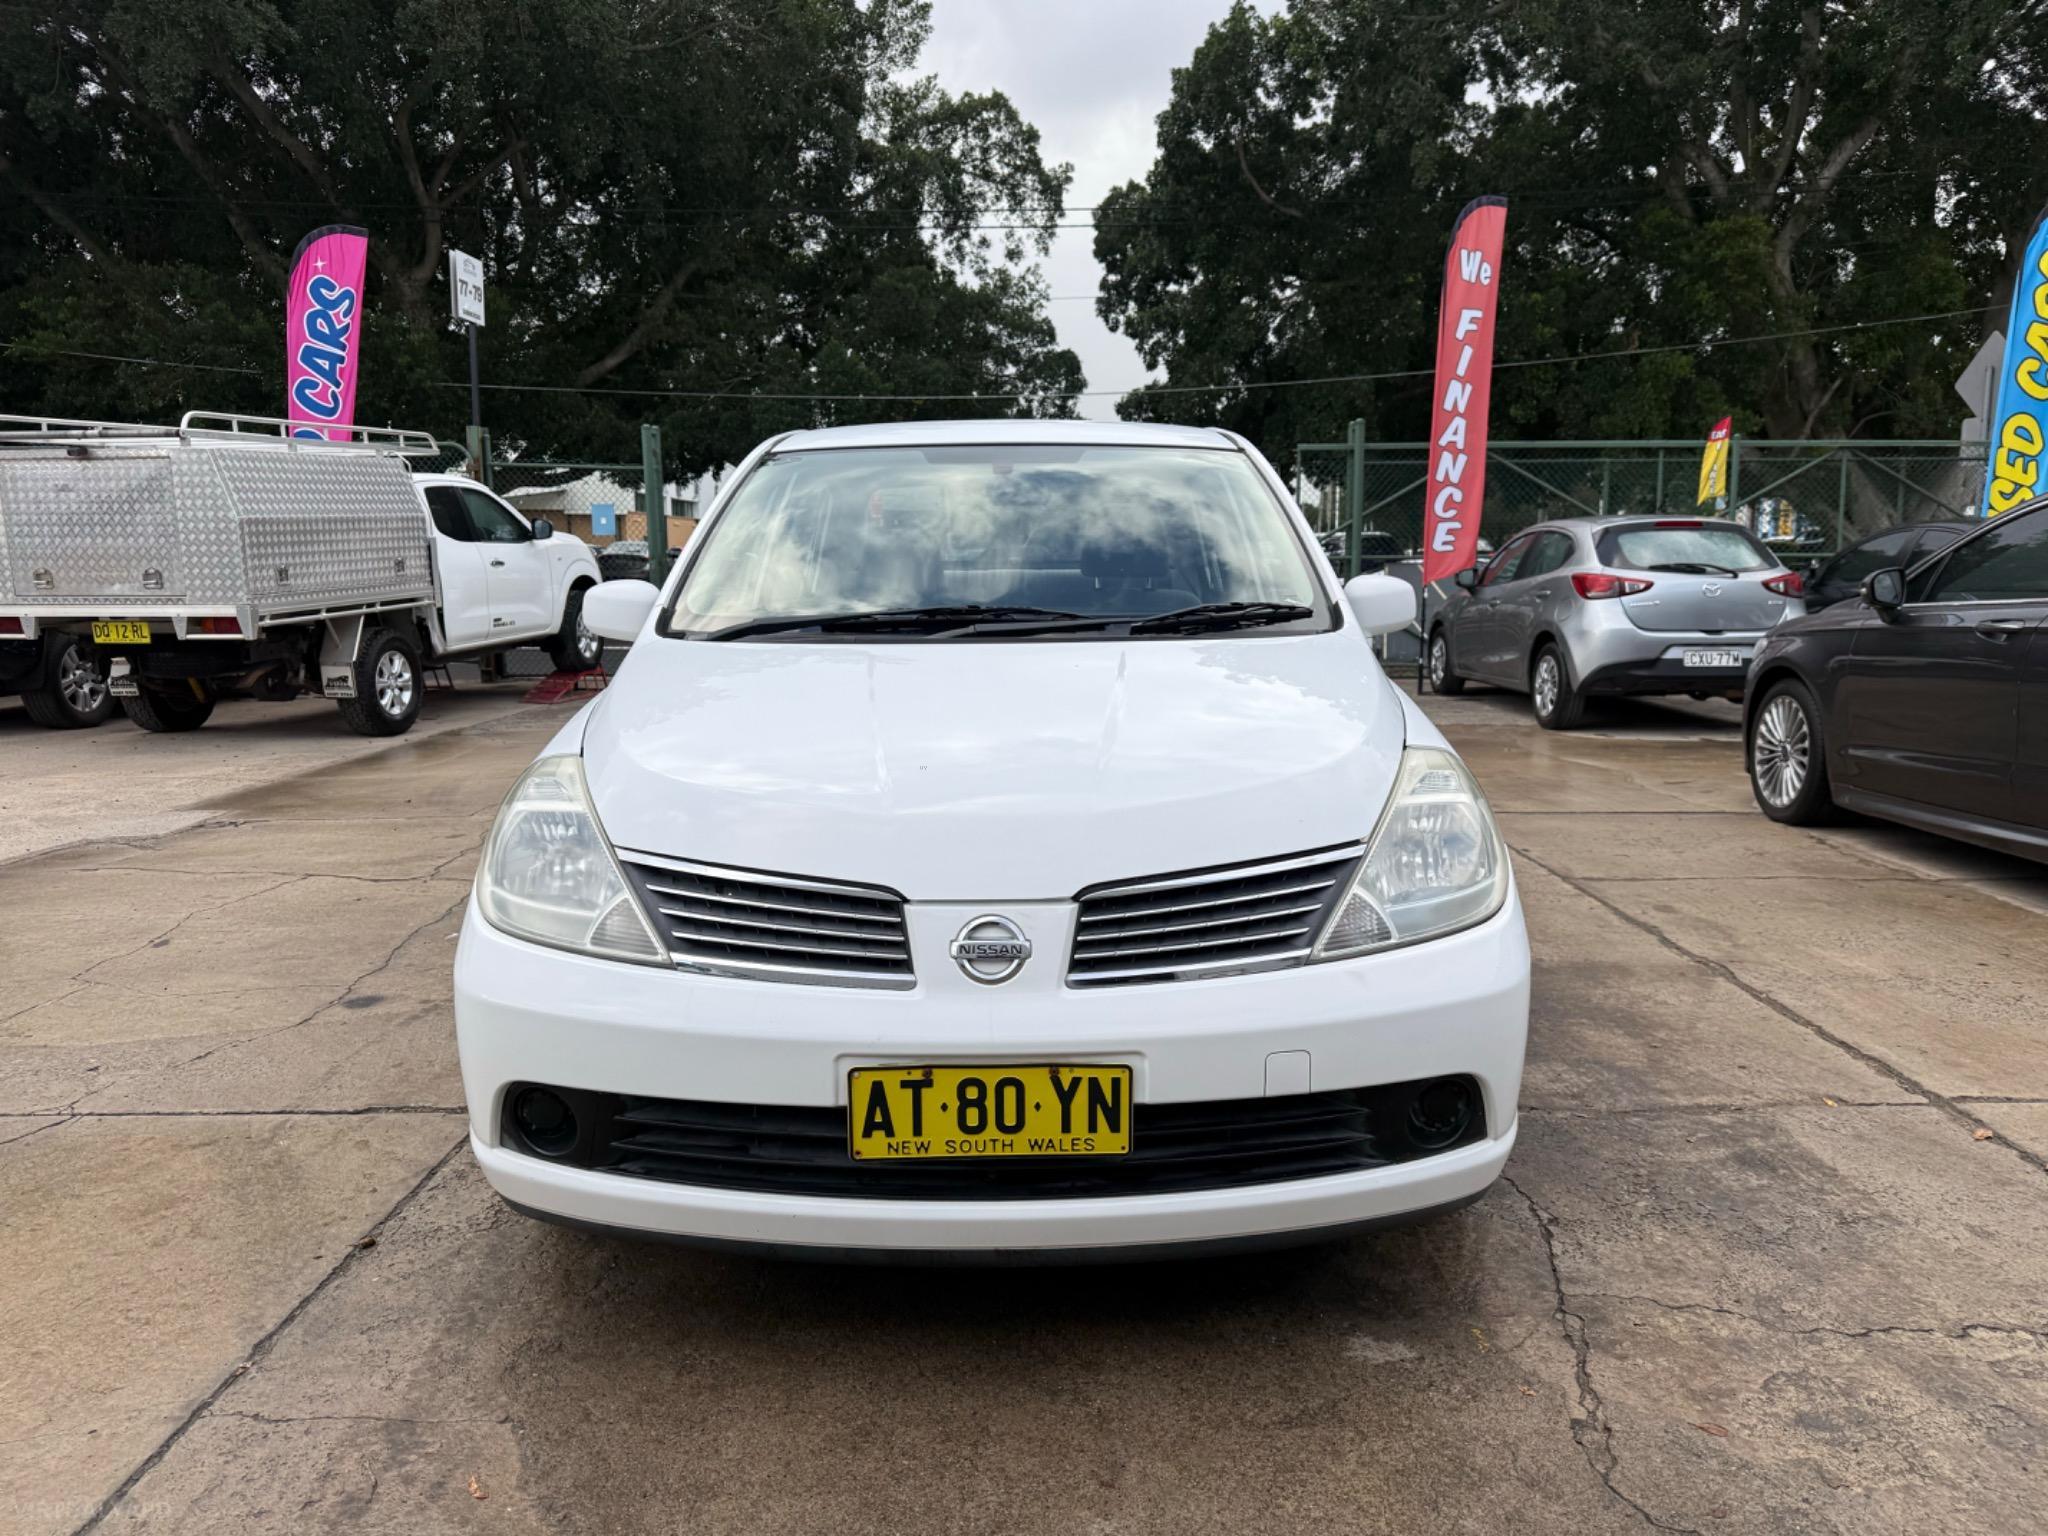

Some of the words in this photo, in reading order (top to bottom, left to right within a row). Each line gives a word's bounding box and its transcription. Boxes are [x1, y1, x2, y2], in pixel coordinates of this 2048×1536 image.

[1460, 247, 1492, 286] We
[293, 274, 357, 420] CARS
[1432, 309, 1484, 552] FINANCE
[1987, 411, 2045, 517] SED
[959, 944, 1023, 955] NISSAN
[887, 1140, 931, 1154] NEW
[945, 1138, 1014, 1154] SOUTH
[1028, 1137, 1096, 1152] WALES
